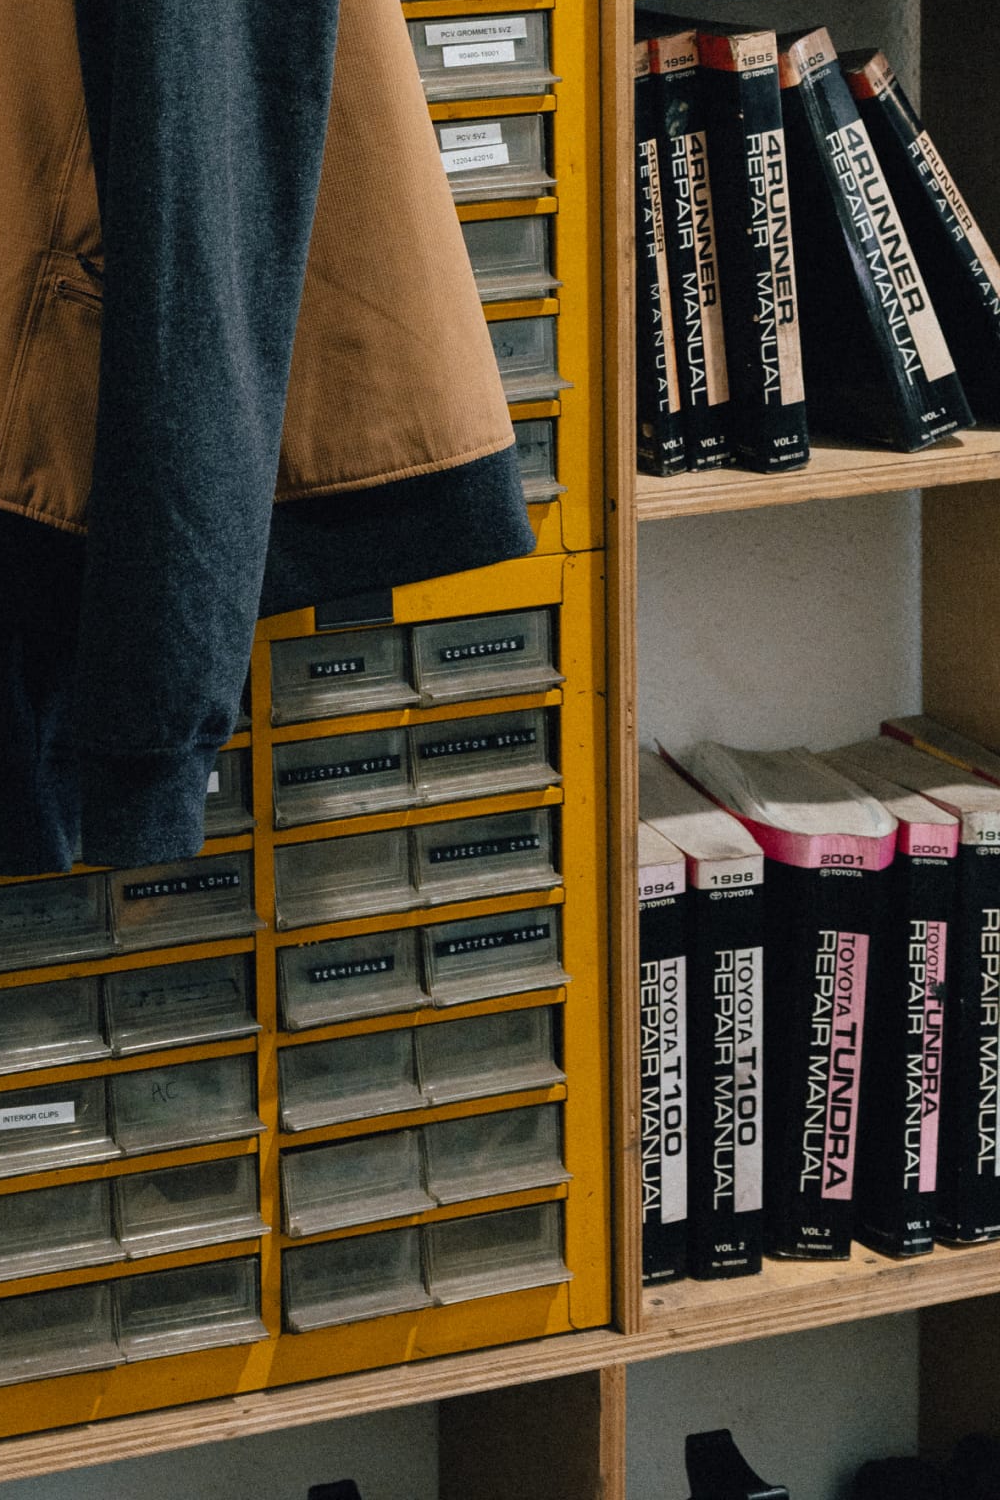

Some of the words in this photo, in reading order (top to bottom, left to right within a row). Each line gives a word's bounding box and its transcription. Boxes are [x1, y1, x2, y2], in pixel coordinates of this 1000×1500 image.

[456, 27, 497, 38] GROMMETS
[664, 54, 695, 68] 1994
[741, 52, 774, 67] 1995
[687, 133, 717, 309] 4RUNNER
[744, 134, 770, 249] REPAIR
[766, 133, 795, 327] 4RUNNER
[846, 127, 926, 317] 4RUNNER
[919, 133, 974, 233] 4RUNNER
[825, 130, 875, 242] REPAIR
[866, 248, 925, 387] MANUAL
[756, 271, 781, 406] MANUAL
[709, 871, 754, 886] 1998
[820, 852, 865, 867] 2001
[314, 961, 387, 981] TERMINALS
[449, 936, 504, 954] BATTERY
[513, 928, 546, 943] TERM
[811, 929, 838, 1047] REPAIR
[836, 935, 856, 1018] TOYOTA
[640, 962, 660, 1077] REPAIR
[661, 961, 679, 1054] TOYOTA
[714, 951, 735, 1067] REPAIR
[736, 952, 756, 1045] TOYOTA
[2, 1112, 37, 1124] INTERIOR
[38, 1110, 60, 1121] CLIPS
[664, 1056, 682, 1158] T100
[713, 1075, 734, 1211] MANUAL
[737, 1046, 757, 1146] T100
[800, 1055, 829, 1194] MANUAL
[825, 1022, 857, 1190] TUNDRA
[641, 1086, 661, 1224] MANUAL
